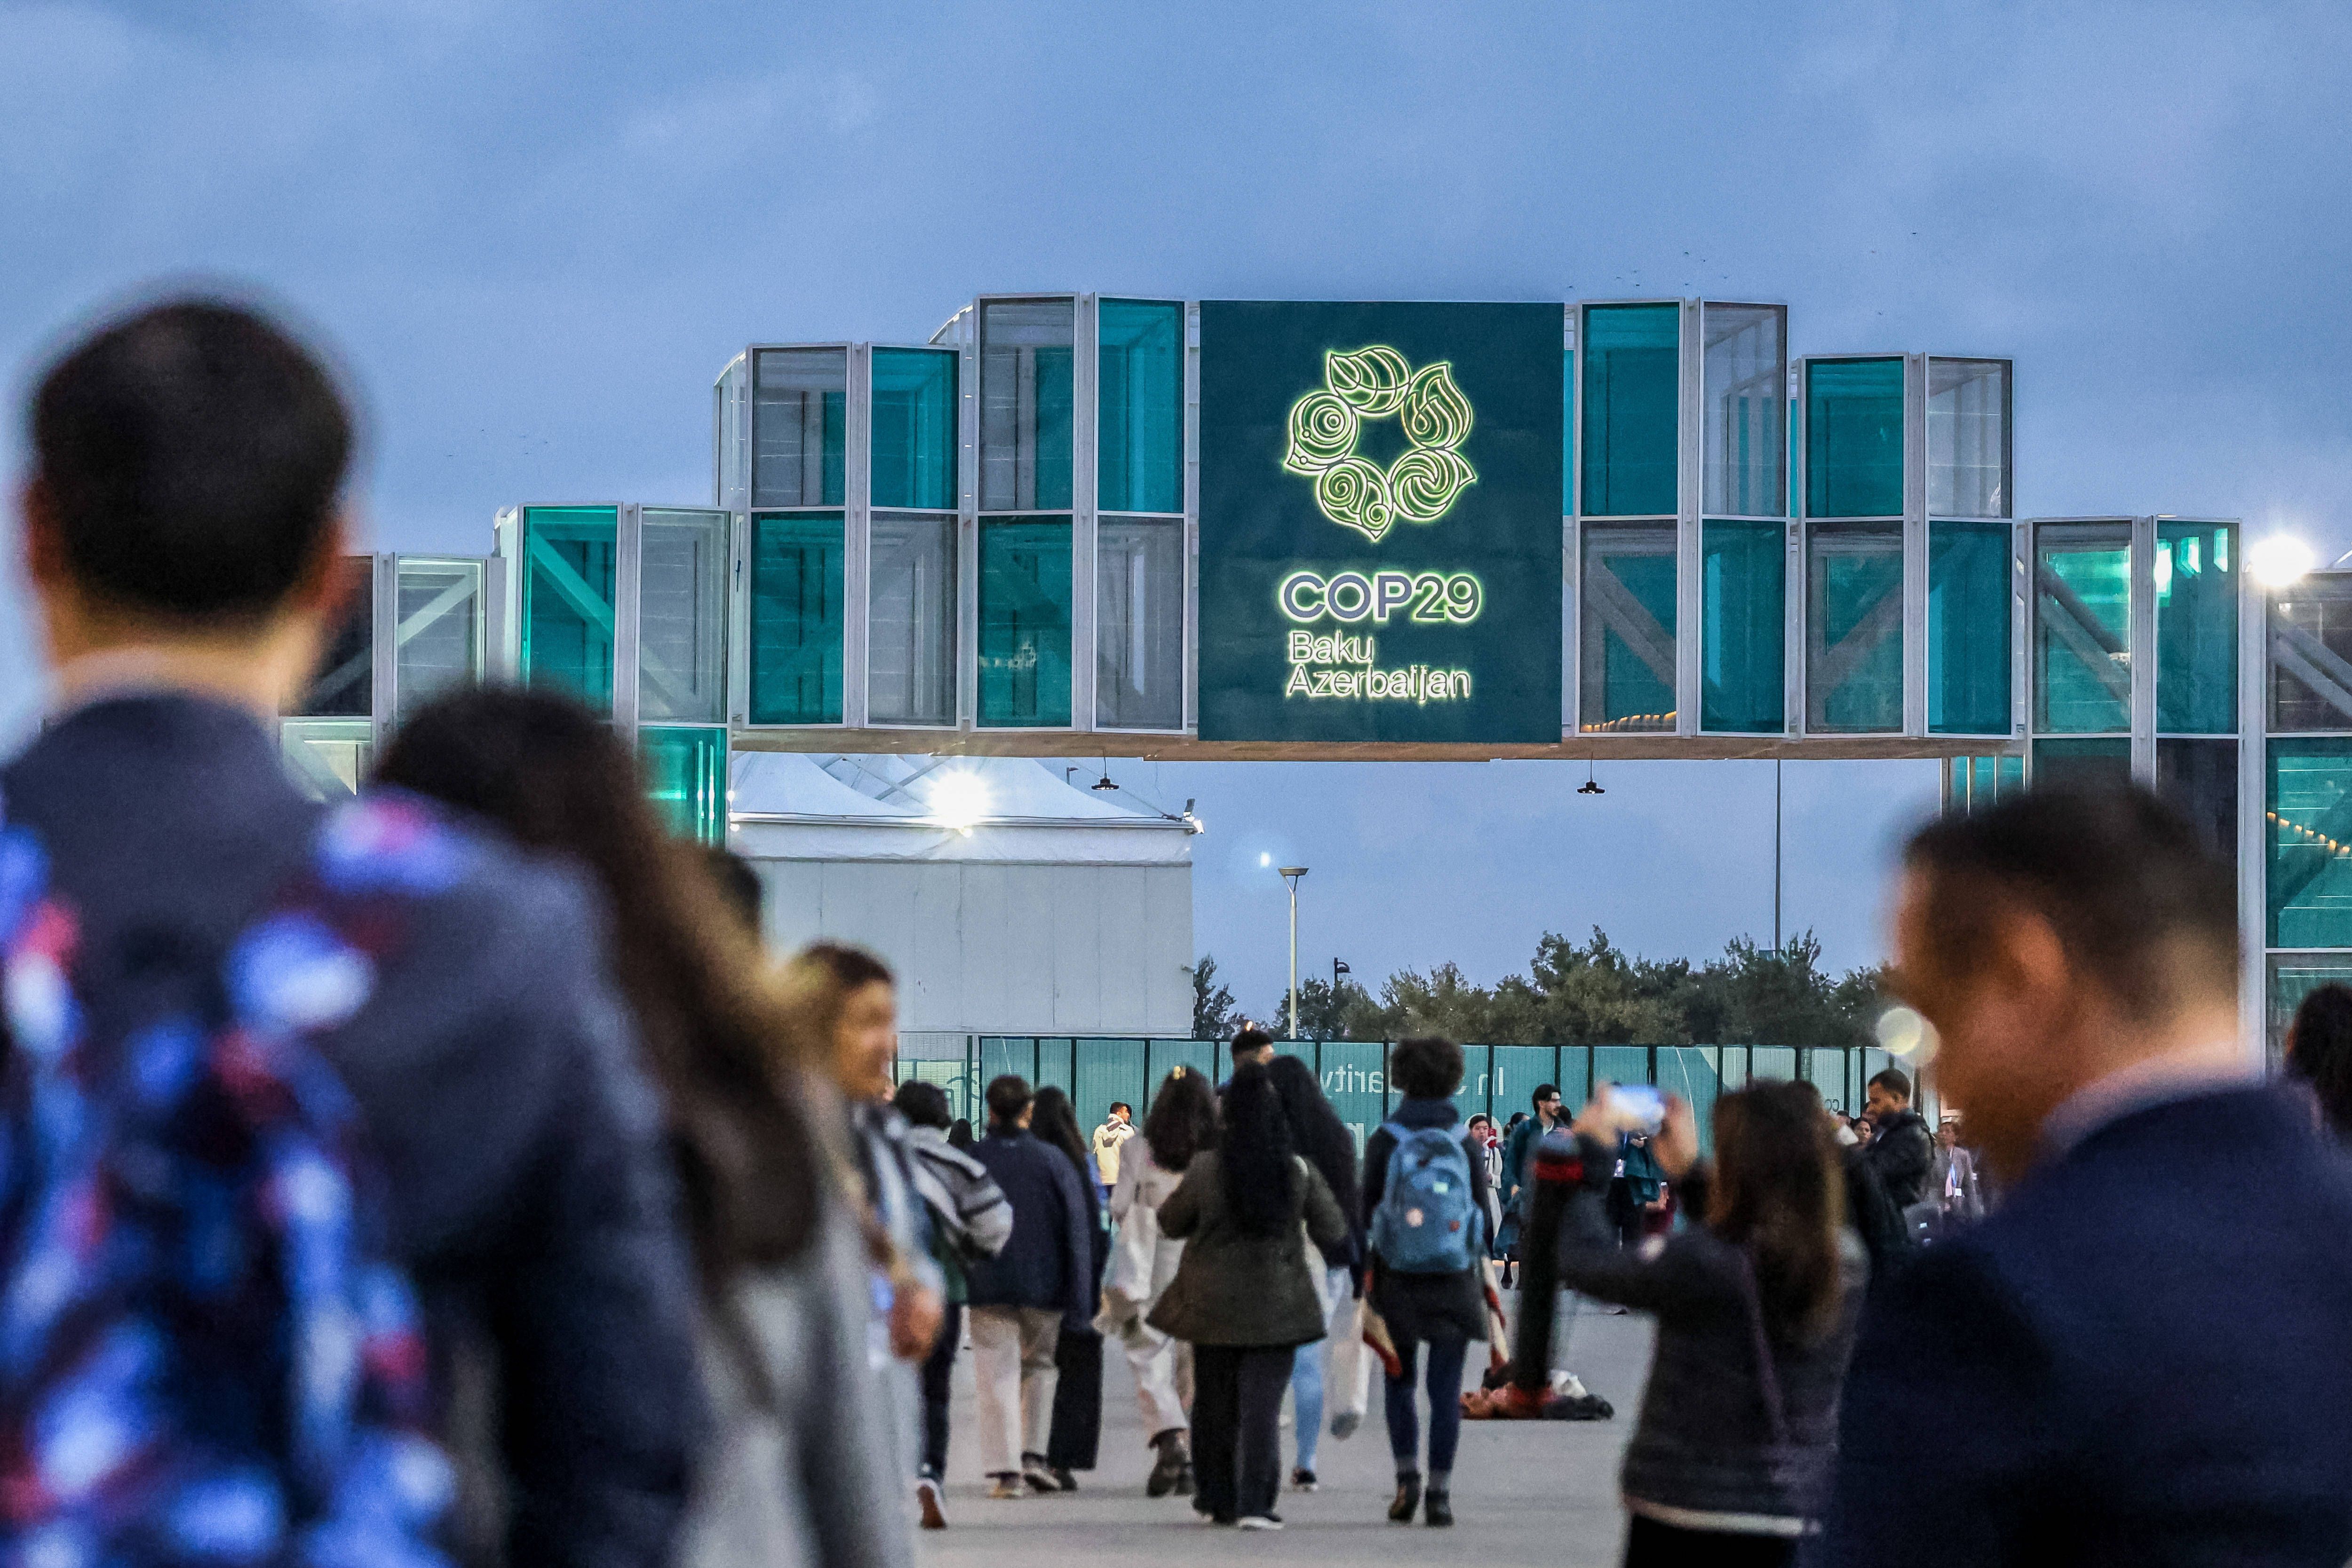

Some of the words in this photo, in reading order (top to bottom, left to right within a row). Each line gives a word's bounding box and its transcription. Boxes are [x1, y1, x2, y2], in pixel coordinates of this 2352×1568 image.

[1280, 573, 1481, 621] COP29
[1289, 630, 1374, 663] Baku
[1287, 665, 1471, 704] Azerbaijan
